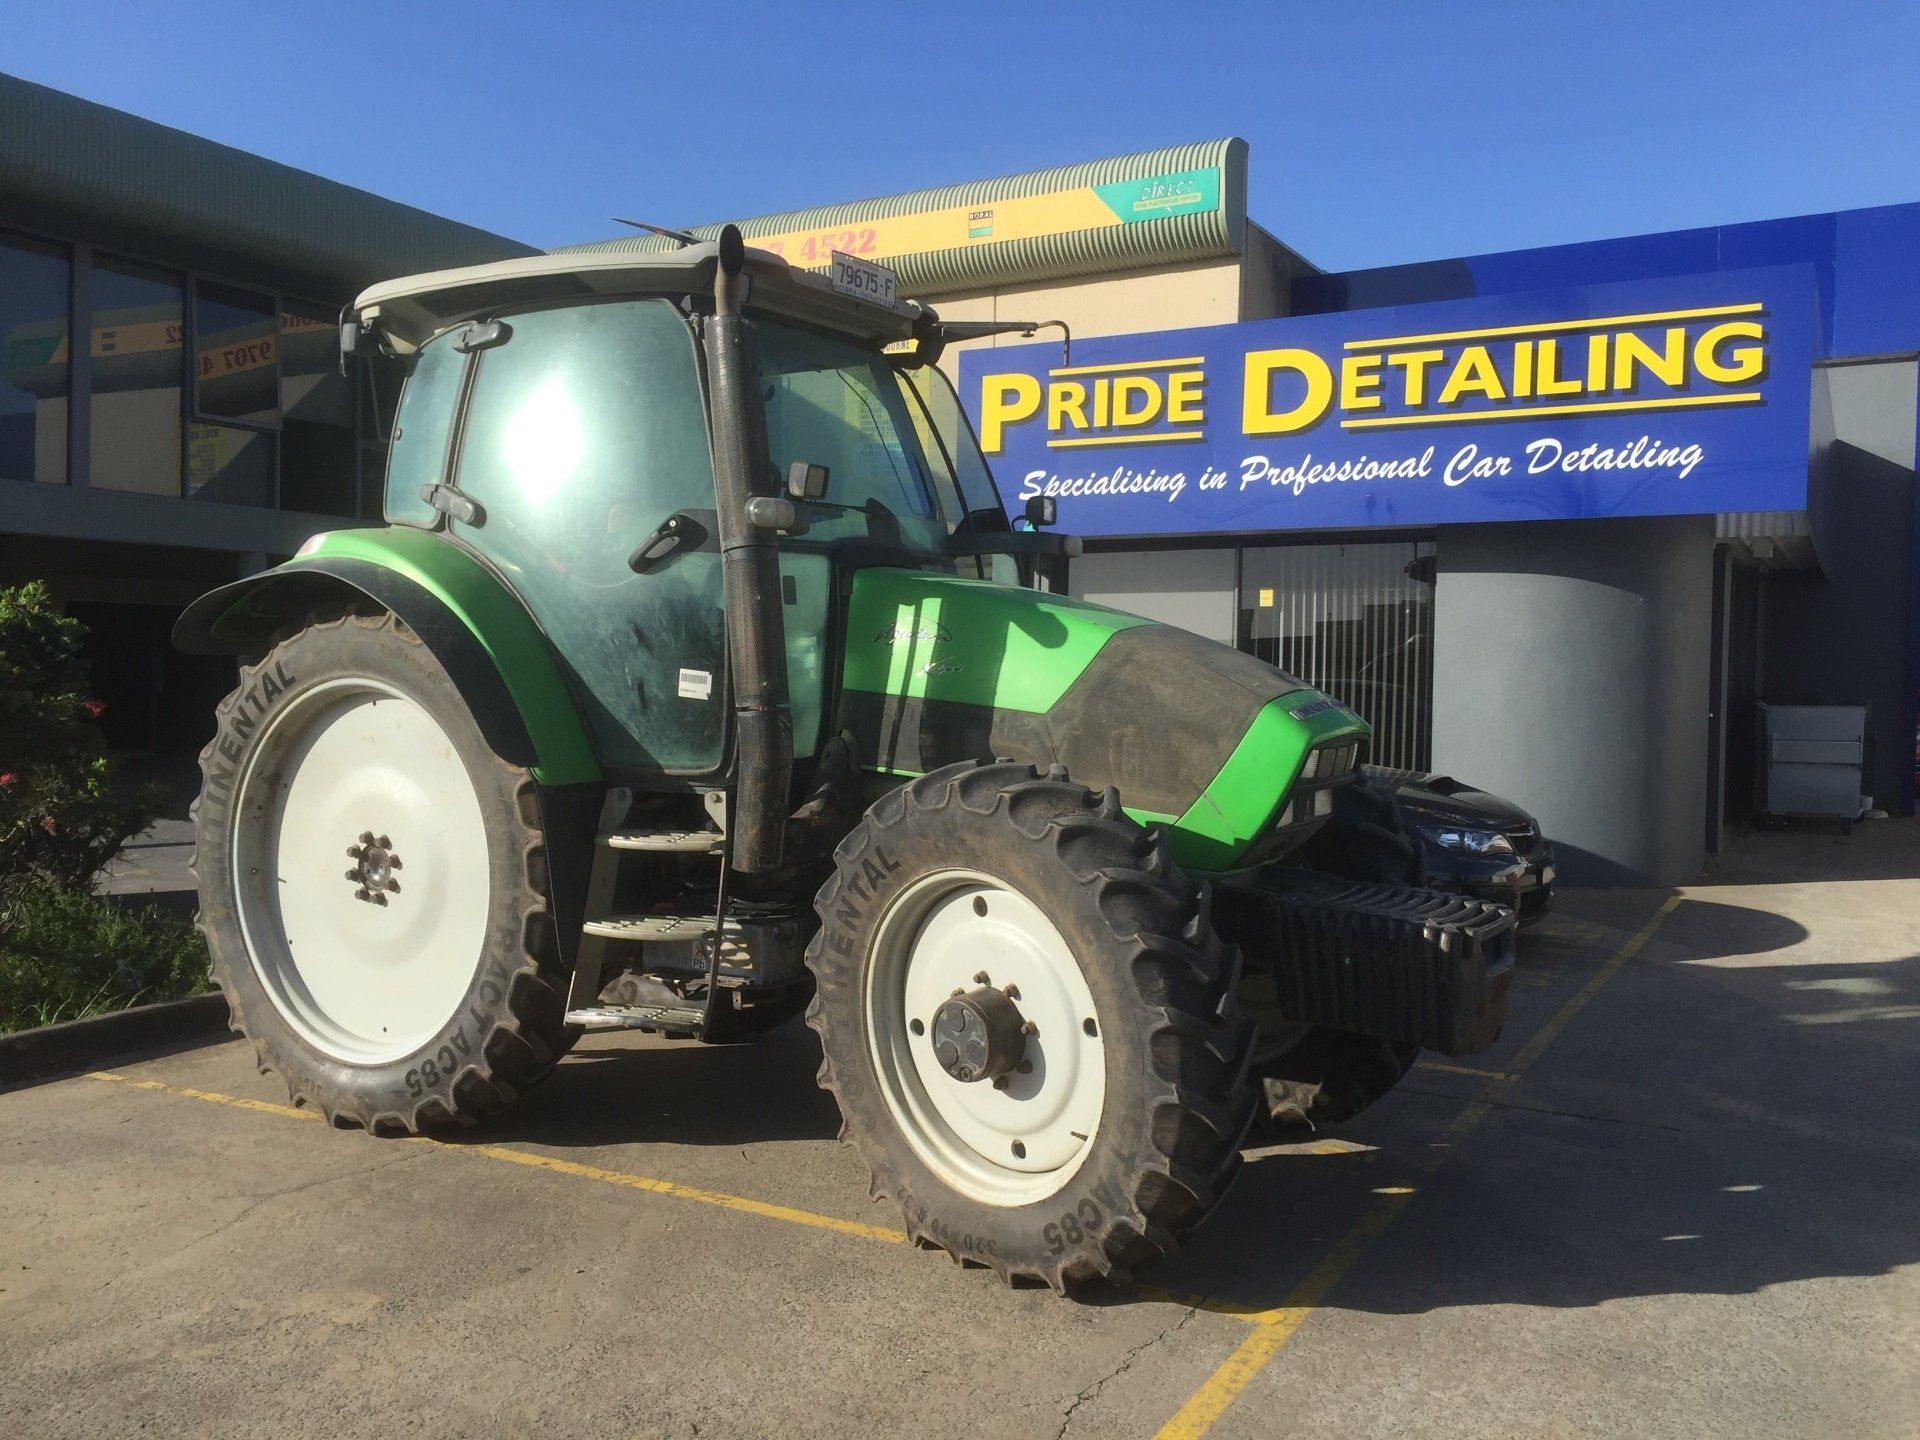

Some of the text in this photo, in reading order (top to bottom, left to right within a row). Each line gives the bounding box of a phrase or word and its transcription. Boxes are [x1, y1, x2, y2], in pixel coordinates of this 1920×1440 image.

[800, 228, 877, 262] 4522
[979, 372, 1205, 454] PRIDE
[1242, 321, 1764, 435] DETAILING
[1018, 435, 1705, 503] Specialising in Professional Car Detailing
[403, 1023, 473, 1101] AC85
[1043, 1173, 1118, 1257] AC85
